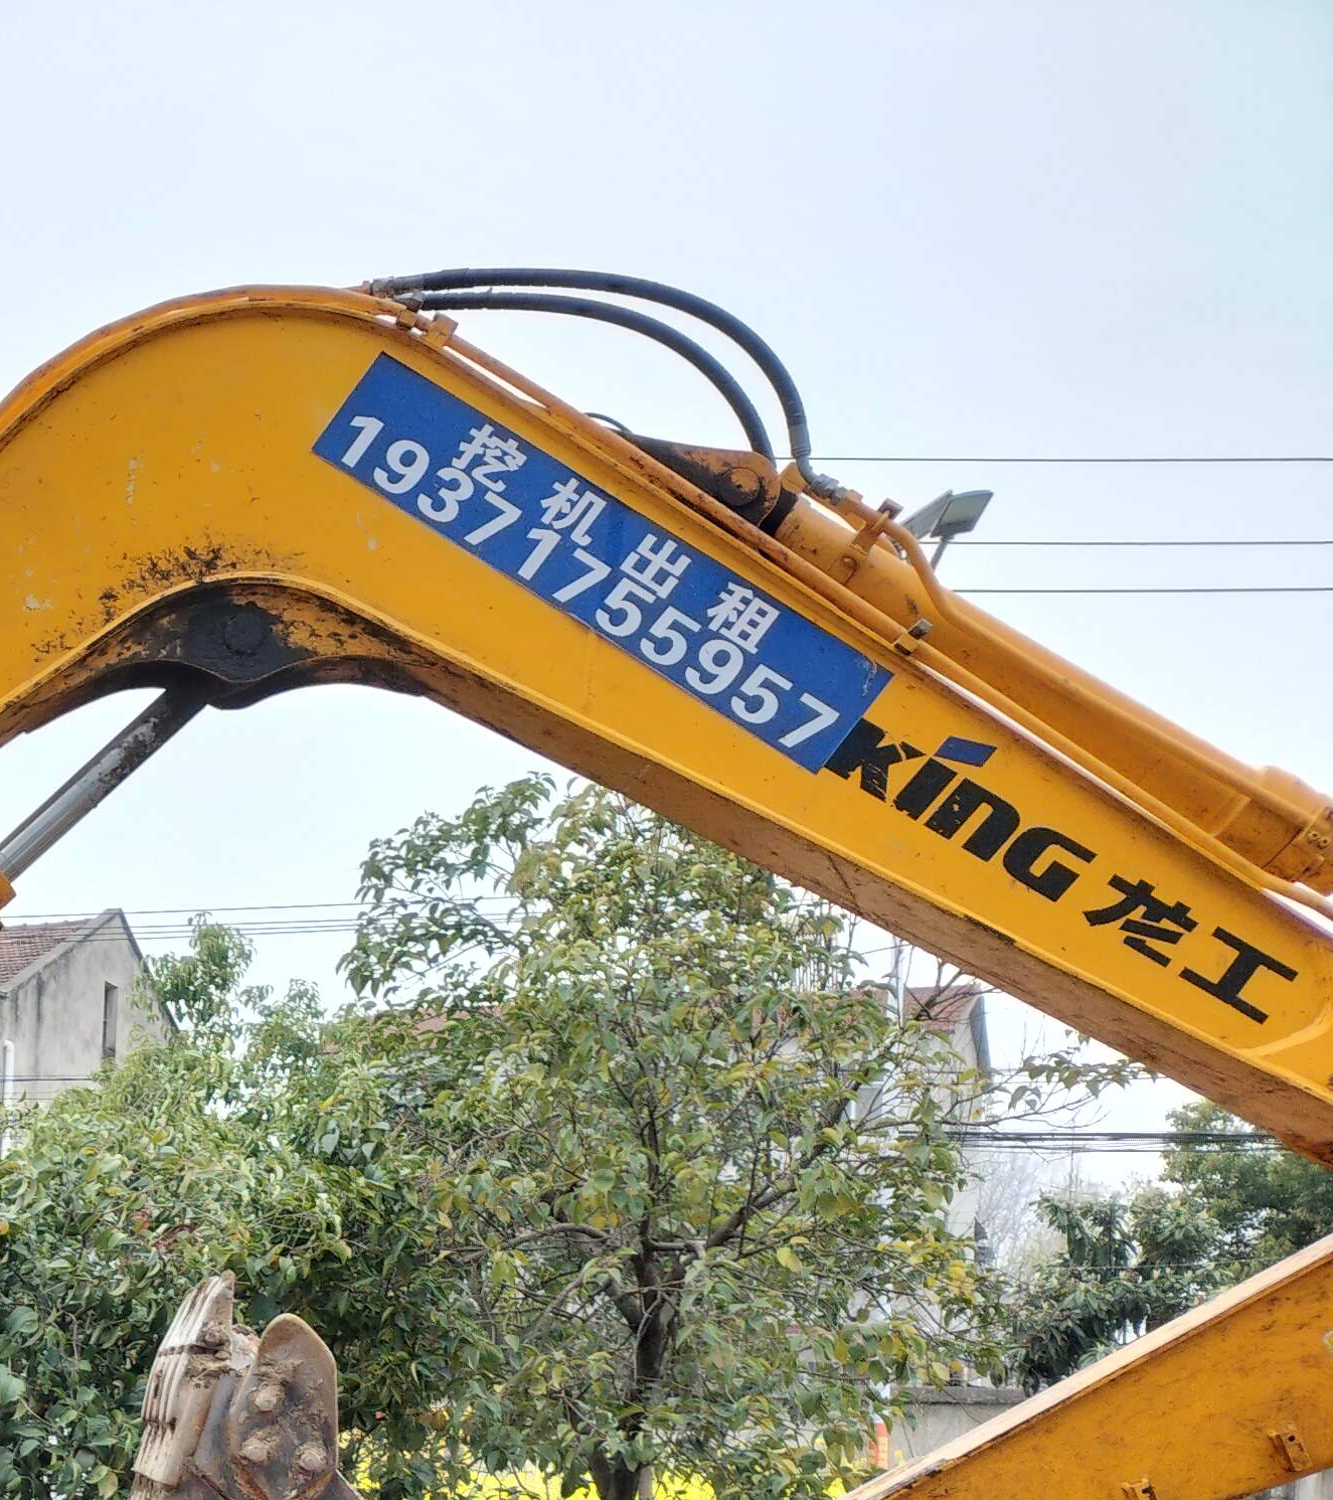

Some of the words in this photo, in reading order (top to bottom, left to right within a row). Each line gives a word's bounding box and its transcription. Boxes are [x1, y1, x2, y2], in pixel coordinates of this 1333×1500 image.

[340, 415, 840, 749] 19371755957
[451, 421, 782, 656] 挖机出租
[1082, 873, 1300, 1026] 龙工
